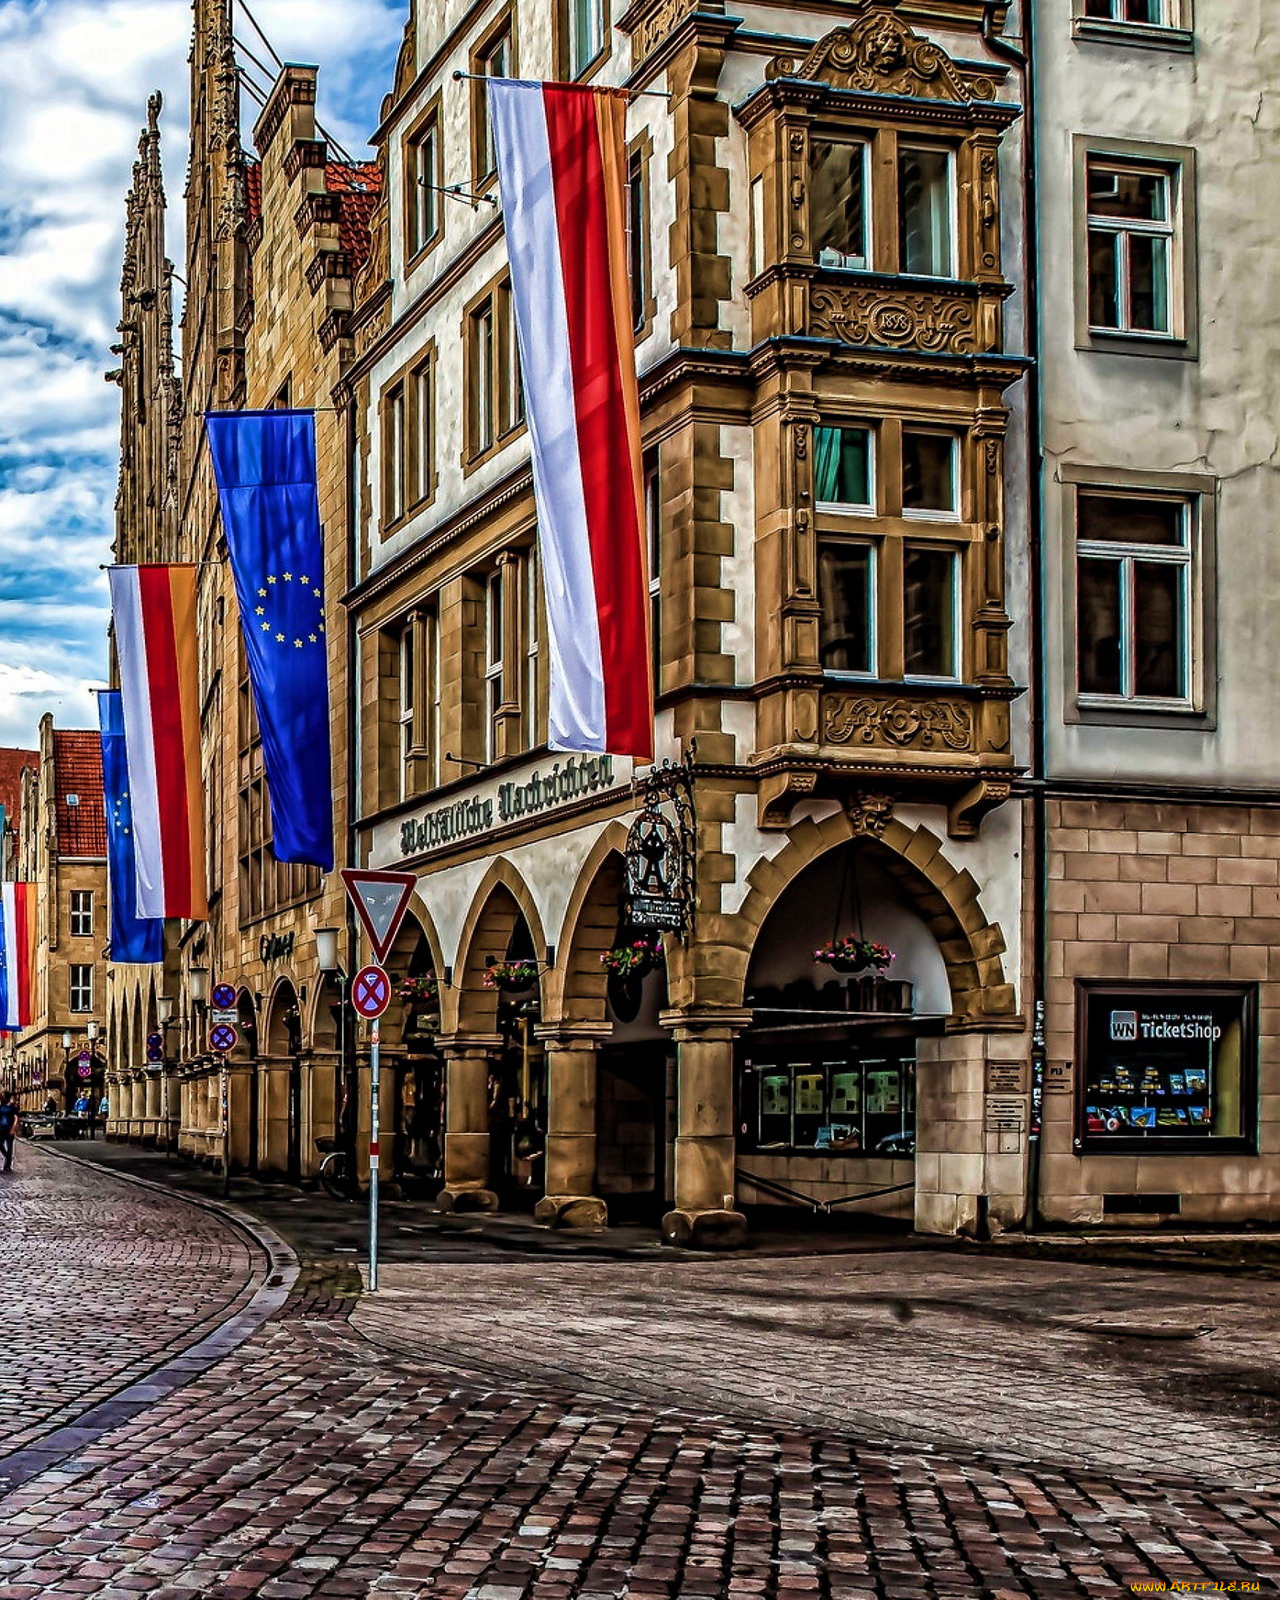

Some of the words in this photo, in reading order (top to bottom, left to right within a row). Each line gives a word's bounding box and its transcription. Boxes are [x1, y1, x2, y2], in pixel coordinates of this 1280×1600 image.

[881, 313, 907, 330] 1898
[498, 754, 615, 822] Nachrichten
[1112, 1022, 1135, 1037] WN
[1140, 1021, 1221, 1041] TicketShop
